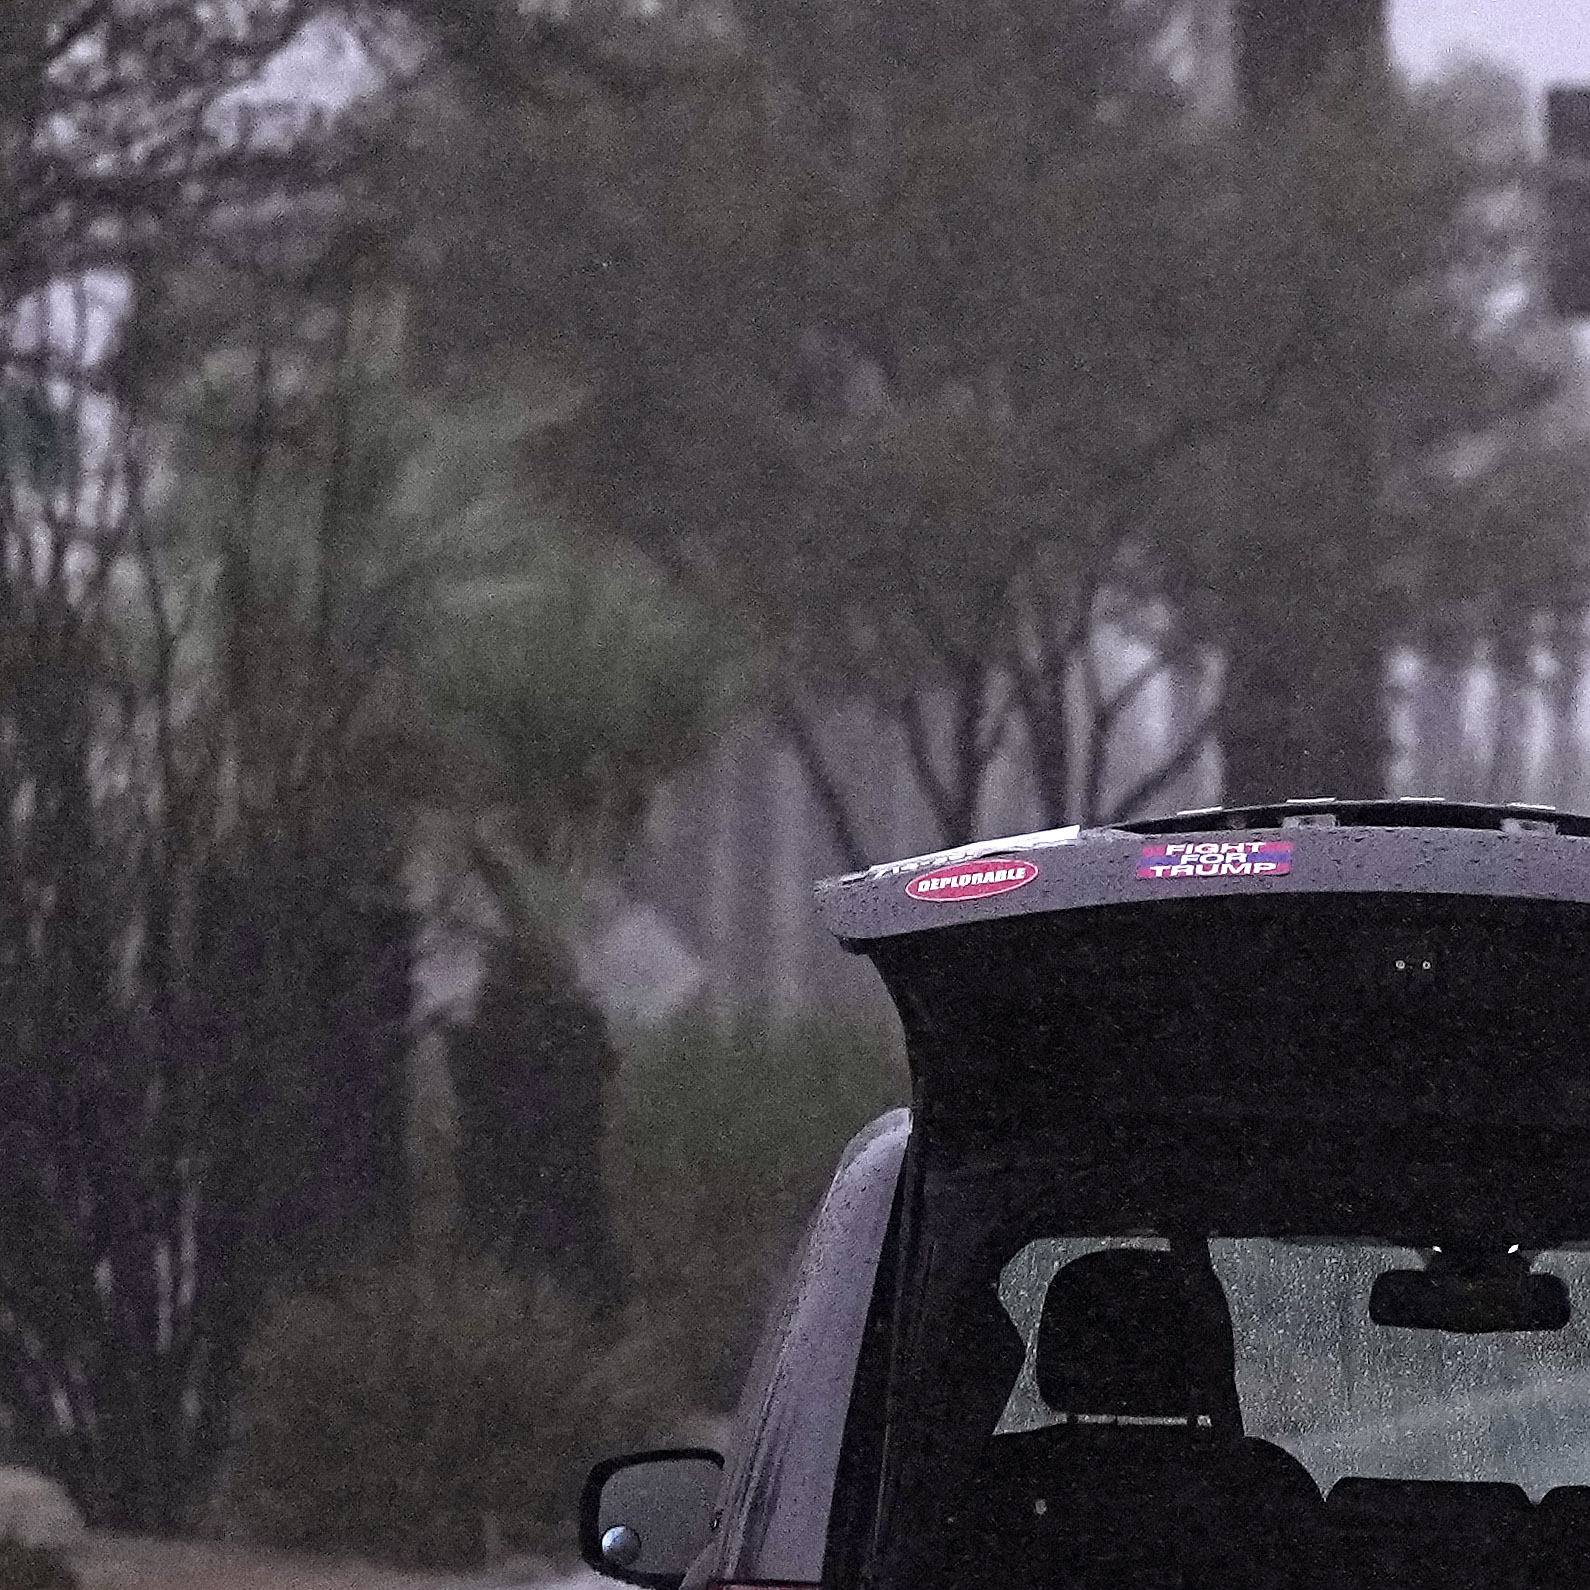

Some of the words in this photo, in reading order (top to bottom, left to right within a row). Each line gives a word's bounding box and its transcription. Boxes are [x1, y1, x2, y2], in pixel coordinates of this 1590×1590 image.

[1165, 842, 1266, 856] FIGHT
[1180, 852, 1248, 865] FOR
[1150, 862, 1277, 877] TRUMP
[917, 867, 1026, 893] DEPLORABLE
